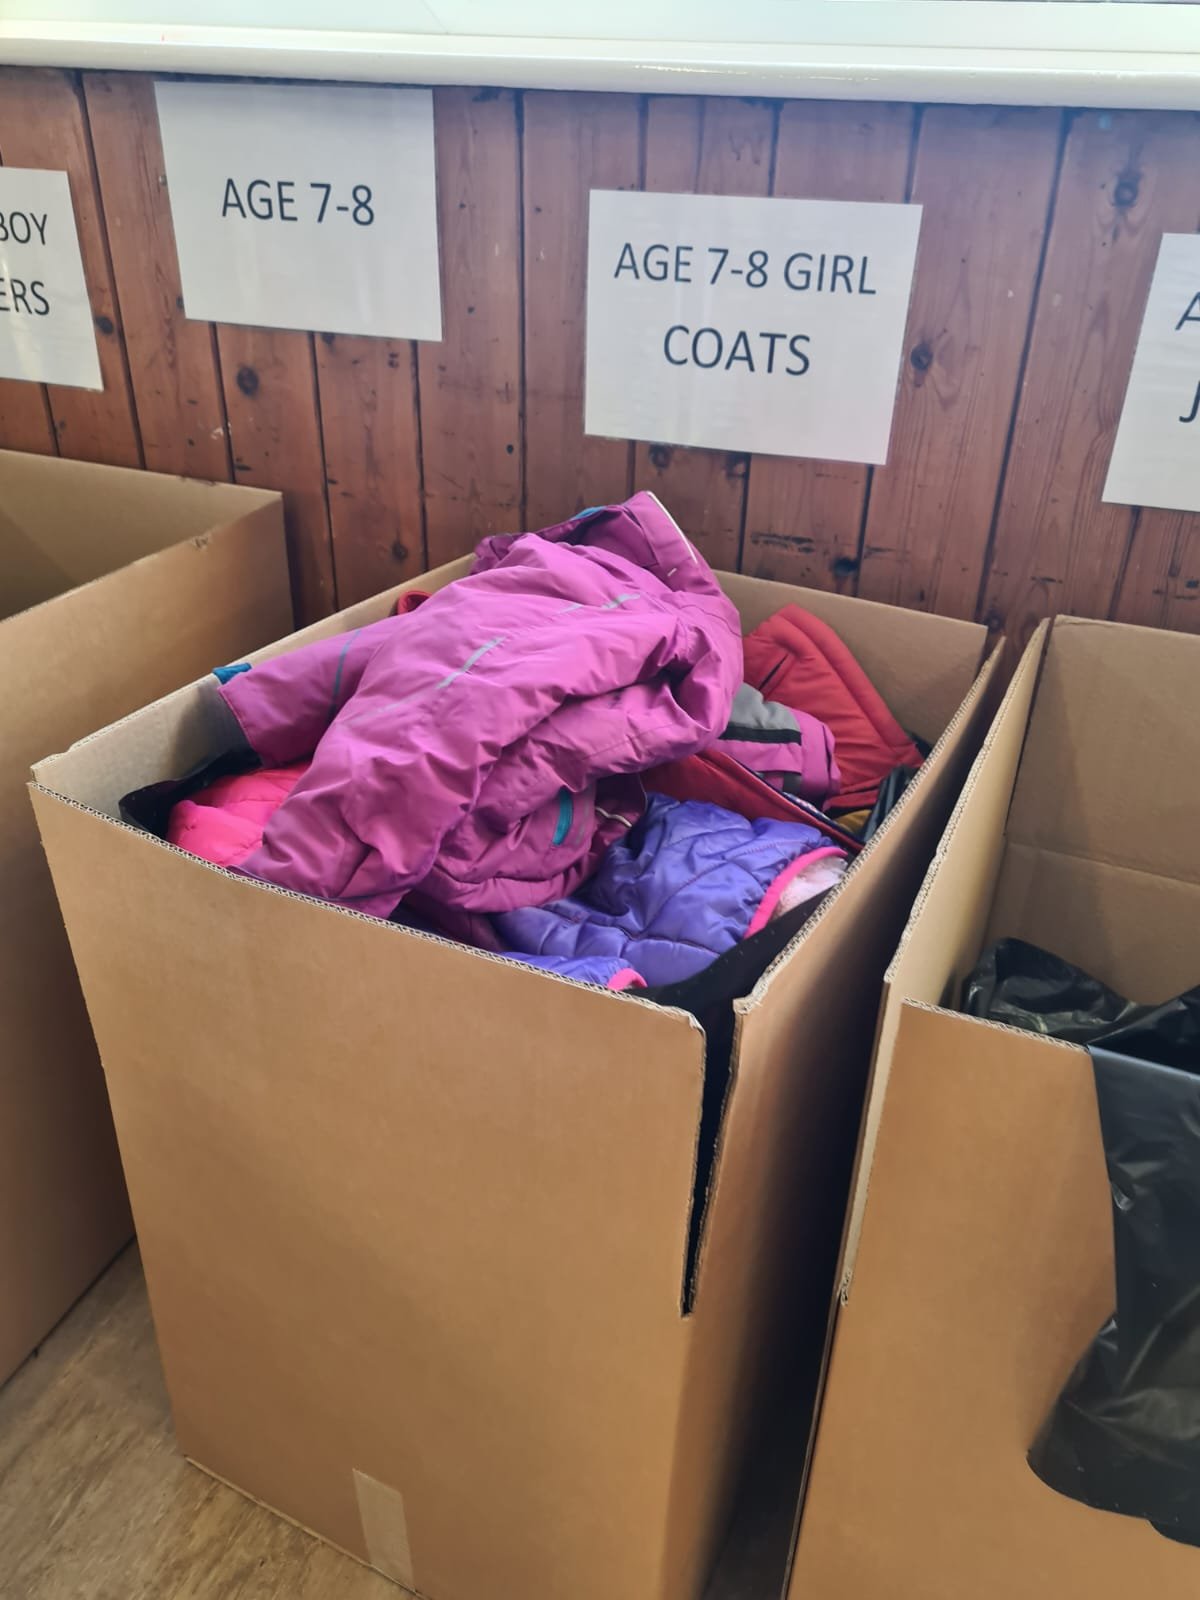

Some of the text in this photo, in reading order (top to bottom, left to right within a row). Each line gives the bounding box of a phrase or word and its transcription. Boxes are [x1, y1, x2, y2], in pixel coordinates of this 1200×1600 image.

[222, 177, 376, 227] AGE 7-8
[614, 242, 877, 296] AGE 7-8 GIRL
[664, 324, 811, 377] COATS
